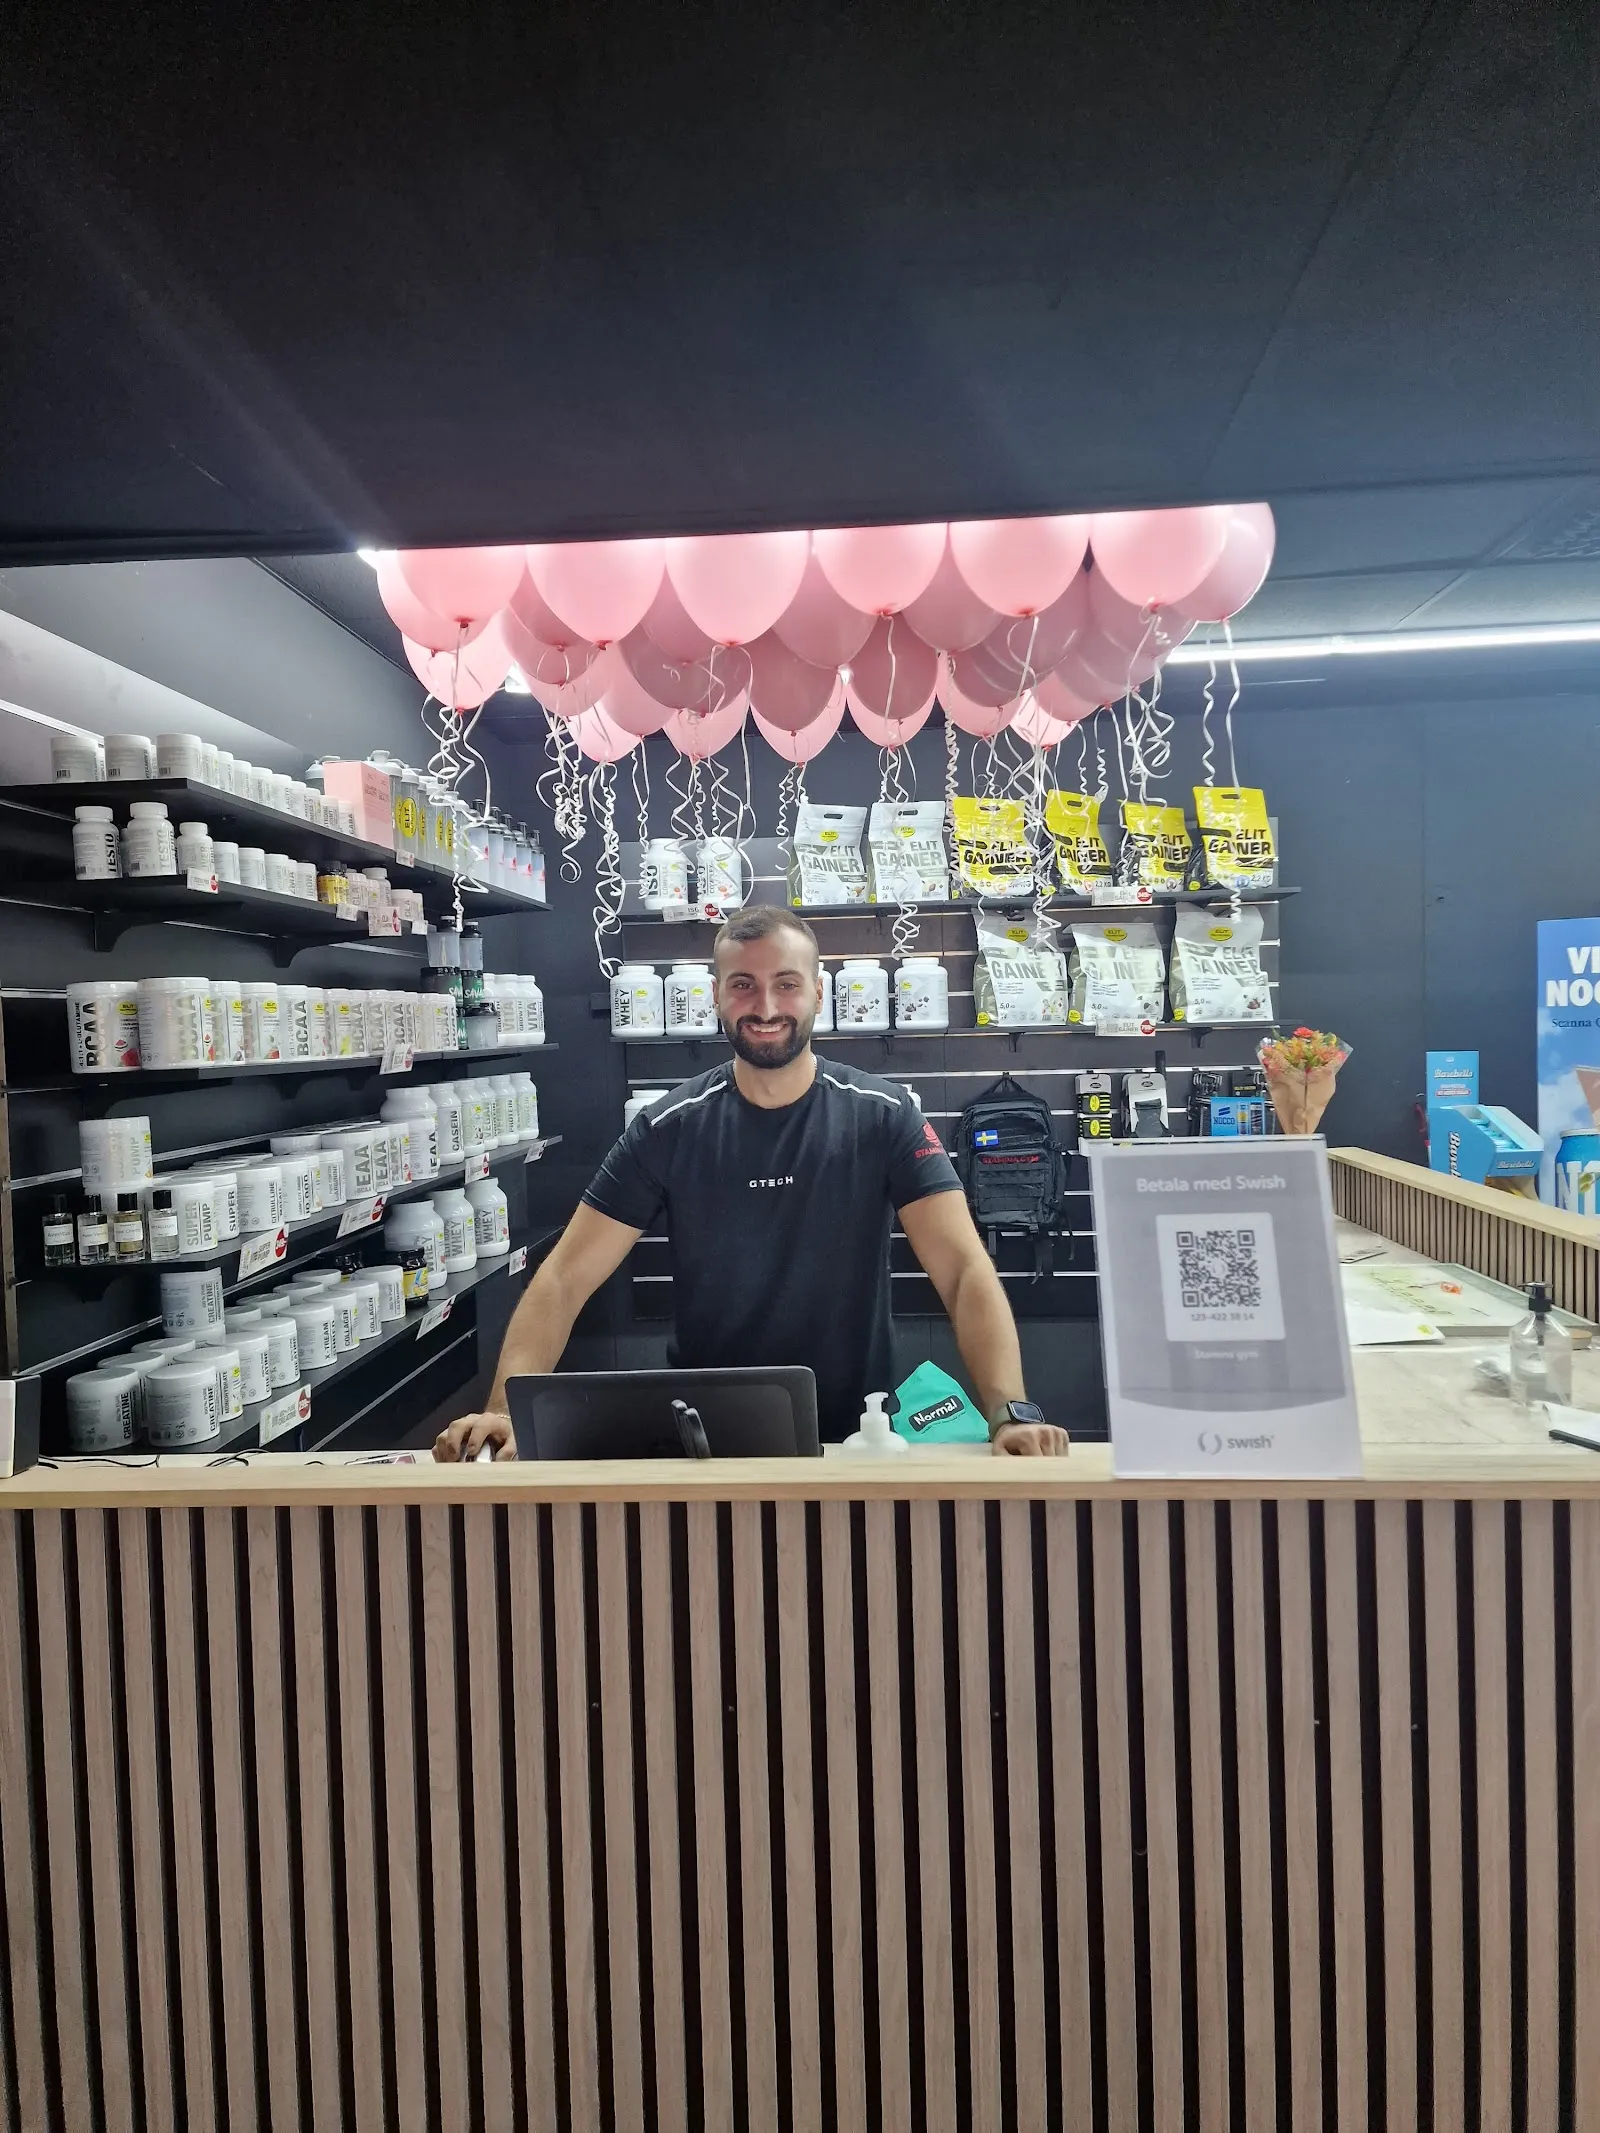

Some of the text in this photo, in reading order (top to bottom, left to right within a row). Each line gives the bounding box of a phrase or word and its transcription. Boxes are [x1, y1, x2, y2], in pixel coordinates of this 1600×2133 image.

[105, 833, 118, 873] TESTO
[156, 829, 170, 869] TESTO
[830, 845, 856, 857] ELIT
[910, 841, 938, 851] ELIT
[1162, 834, 1185, 845] ELIT
[1236, 829, 1267, 840] ELIT
[801, 854, 861, 873] GAINER
[1143, 845, 1191, 862] AINER
[288, 871, 296, 895] ZMA
[306, 874, 314, 897] IRON
[647, 865, 659, 896] ISO
[620, 989, 631, 1026] WHEY
[676, 987, 687, 1024] WHEY
[839, 984, 848, 1020] WHEY
[1545, 978, 1600, 1007] NO
[82, 1001, 108, 1067] BCAA
[294, 1000, 309, 1056] BCAA
[351, 1003, 365, 1053] BCAA
[369, 1003, 385, 1052] BCAA
[504, 1001, 515, 1032] VITA
[527, 1001, 538, 1031] VITA
[1552, 1018, 1592, 1028] Scanna
[1434, 1069, 1474, 1078] Barebells
[450, 1110, 460, 1152] CASEIN
[1213, 1117, 1236, 1125] NOCCO
[130, 1136, 141, 1176] PUMP
[355, 1144, 372, 1187] EAA
[374, 1140, 388, 1180] EAA
[428, 1131, 438, 1168] EAA
[1497, 1159, 1535, 1169] Barebells
[749, 1176, 794, 1188] GTECH
[1136, 1175, 1286, 1193] Betala med Swish
[228, 1190, 237, 1232] SUPER
[269, 1181, 277, 1224] CITRULLINE
[185, 1202, 199, 1246] SUPER
[202, 1203, 213, 1242] PUMP
[450, 1220, 463, 1257] WHEY
[482, 1209, 494, 1243] WHEY
[206, 1282, 215, 1324] CREATINE
[322, 1321, 330, 1360] X-TREAM
[341, 1309, 350, 1347] COLLAGEN
[208, 1385, 217, 1432] CREATINE
[222, 1371, 230, 1415] MONOHYDRATE
[120, 1392, 132, 1439] CREATINE
[913, 1398, 958, 1426] Normal
[1227, 1435, 1272, 1449] swish
